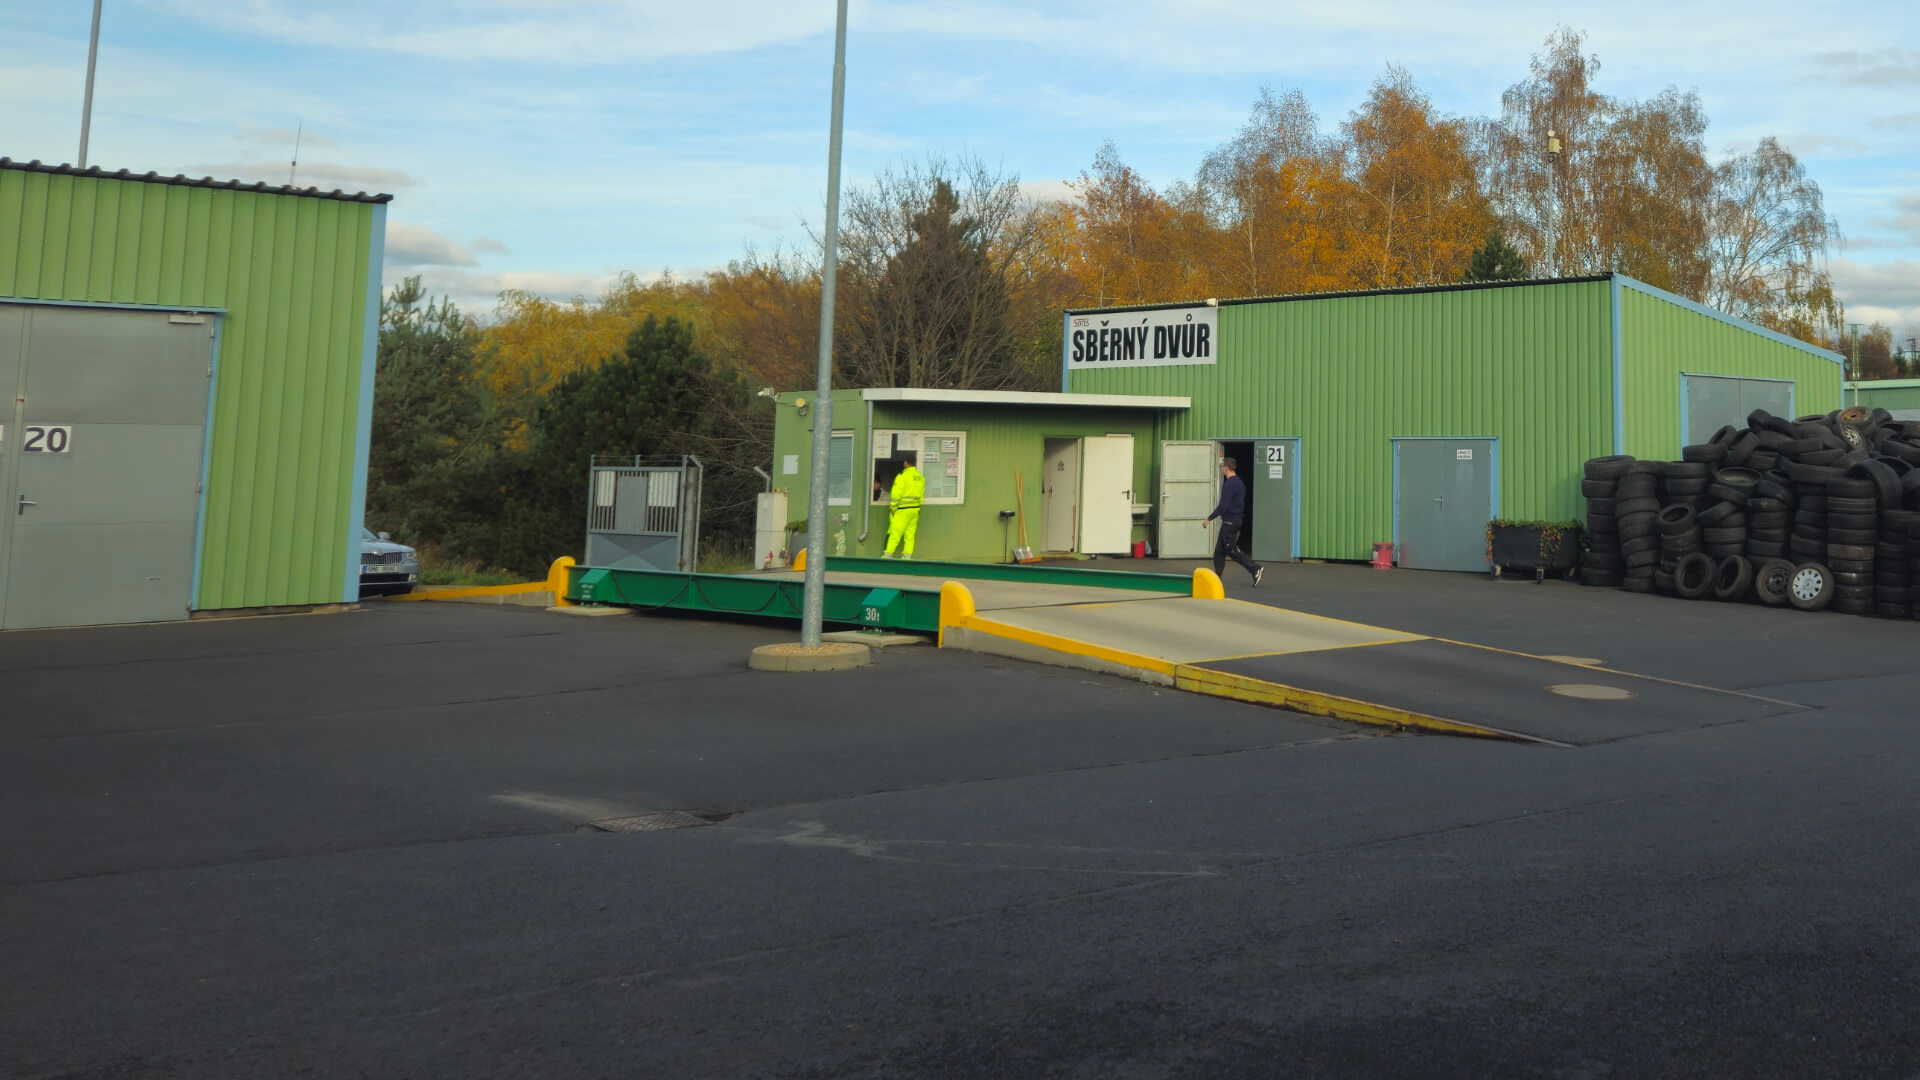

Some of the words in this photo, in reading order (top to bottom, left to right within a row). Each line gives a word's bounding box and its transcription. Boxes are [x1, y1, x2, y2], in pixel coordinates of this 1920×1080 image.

[1073, 318, 1149, 362] SBĚRNÝ
[1153, 313, 1210, 359] DVŮR
[24, 427, 67, 452] 20
[1268, 447, 1283, 462] 21
